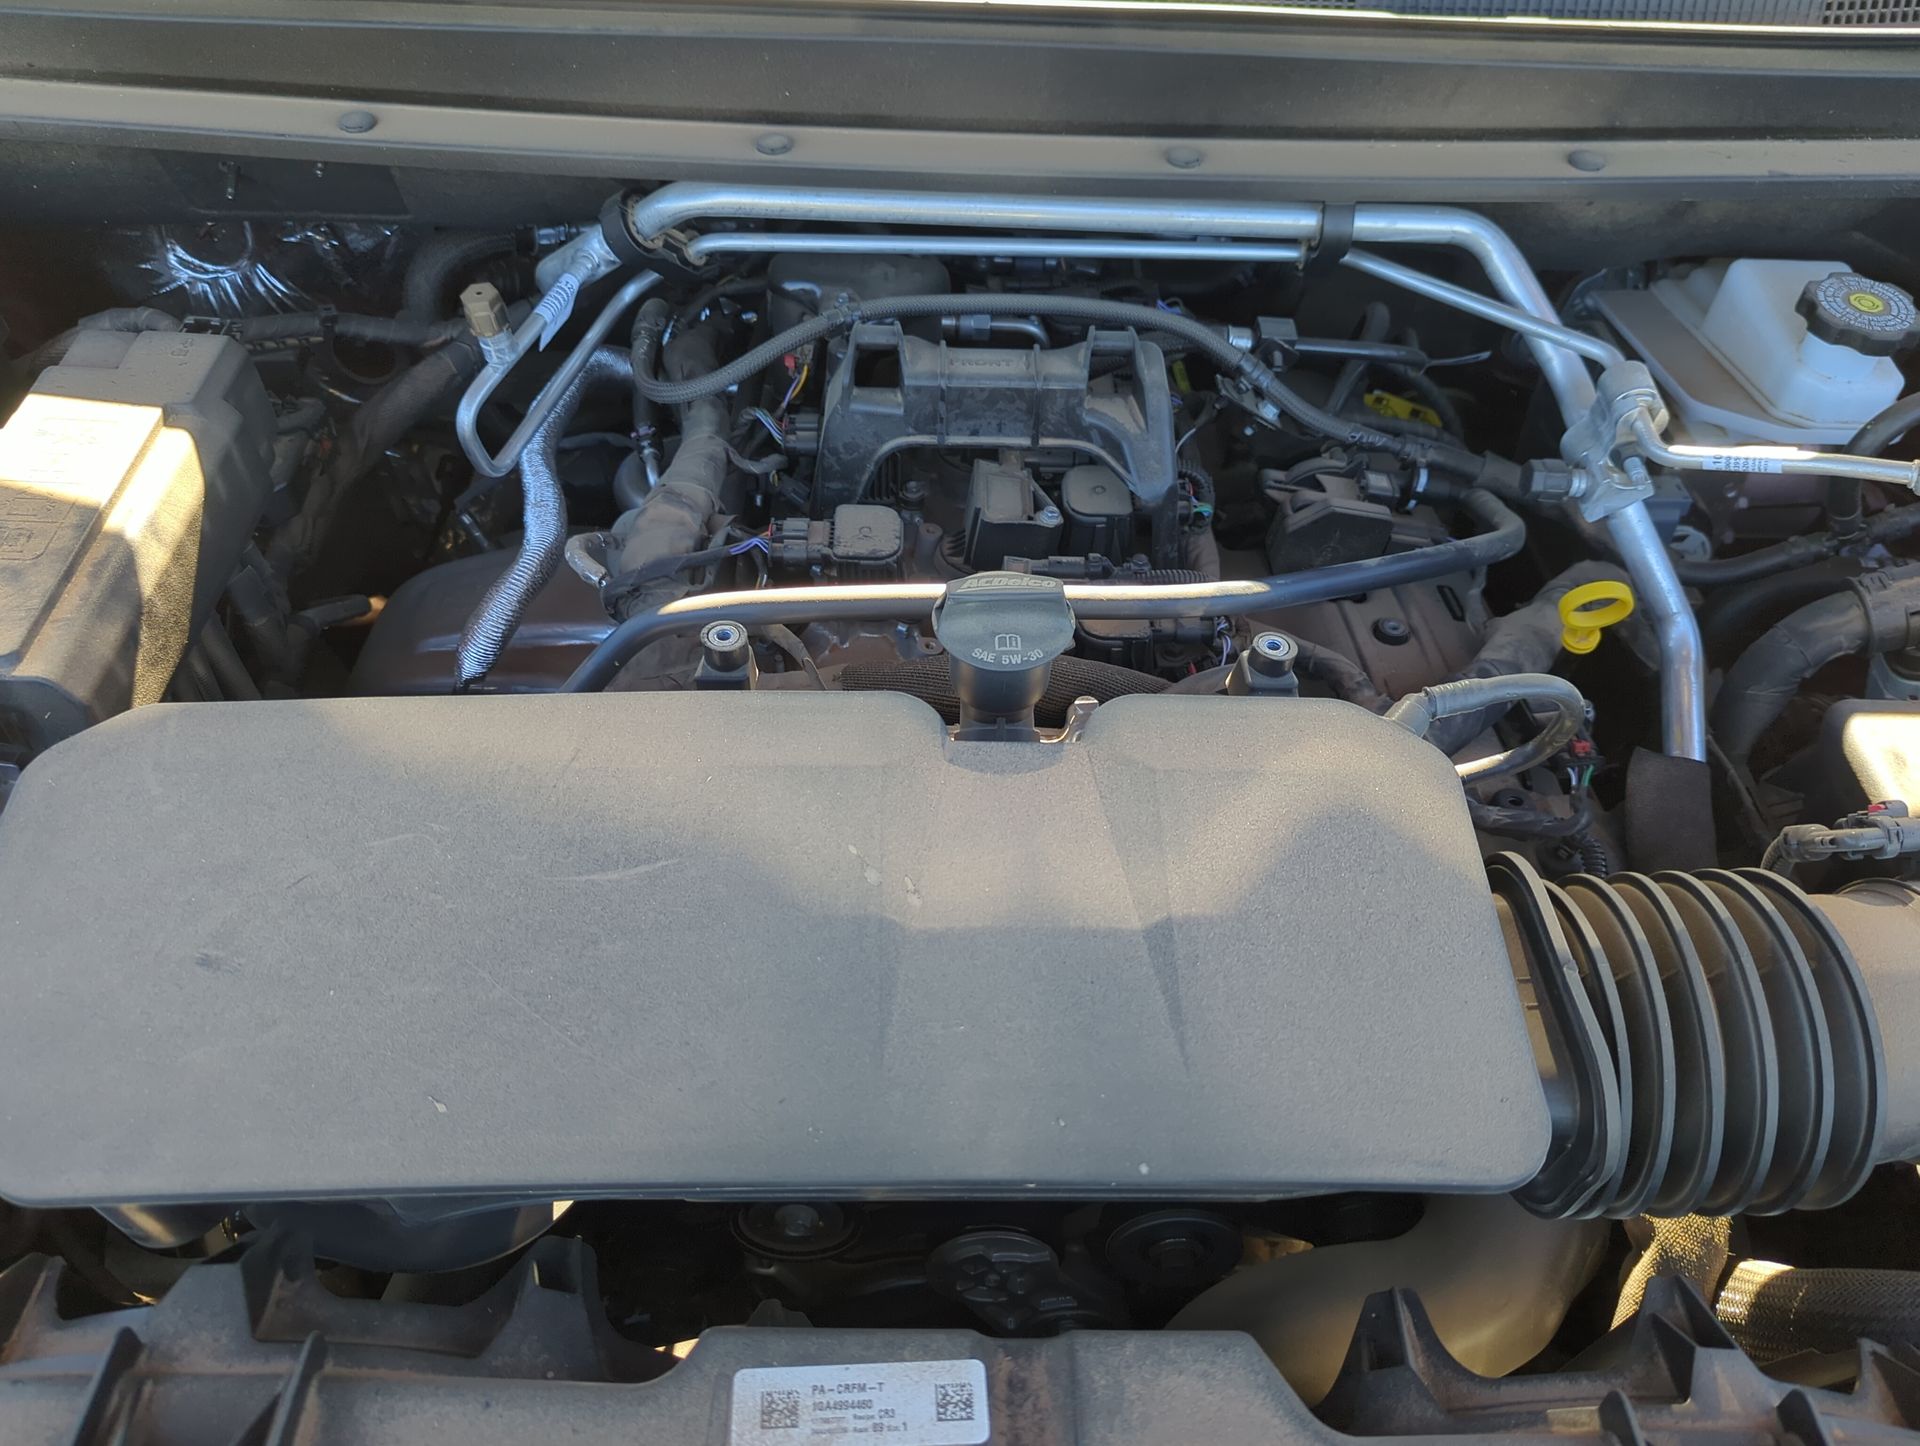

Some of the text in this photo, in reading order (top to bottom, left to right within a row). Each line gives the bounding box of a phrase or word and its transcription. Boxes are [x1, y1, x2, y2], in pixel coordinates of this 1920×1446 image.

[960, 577, 1057, 589] ACDelco
[971, 647, 1044, 665] SAE 5W-30
